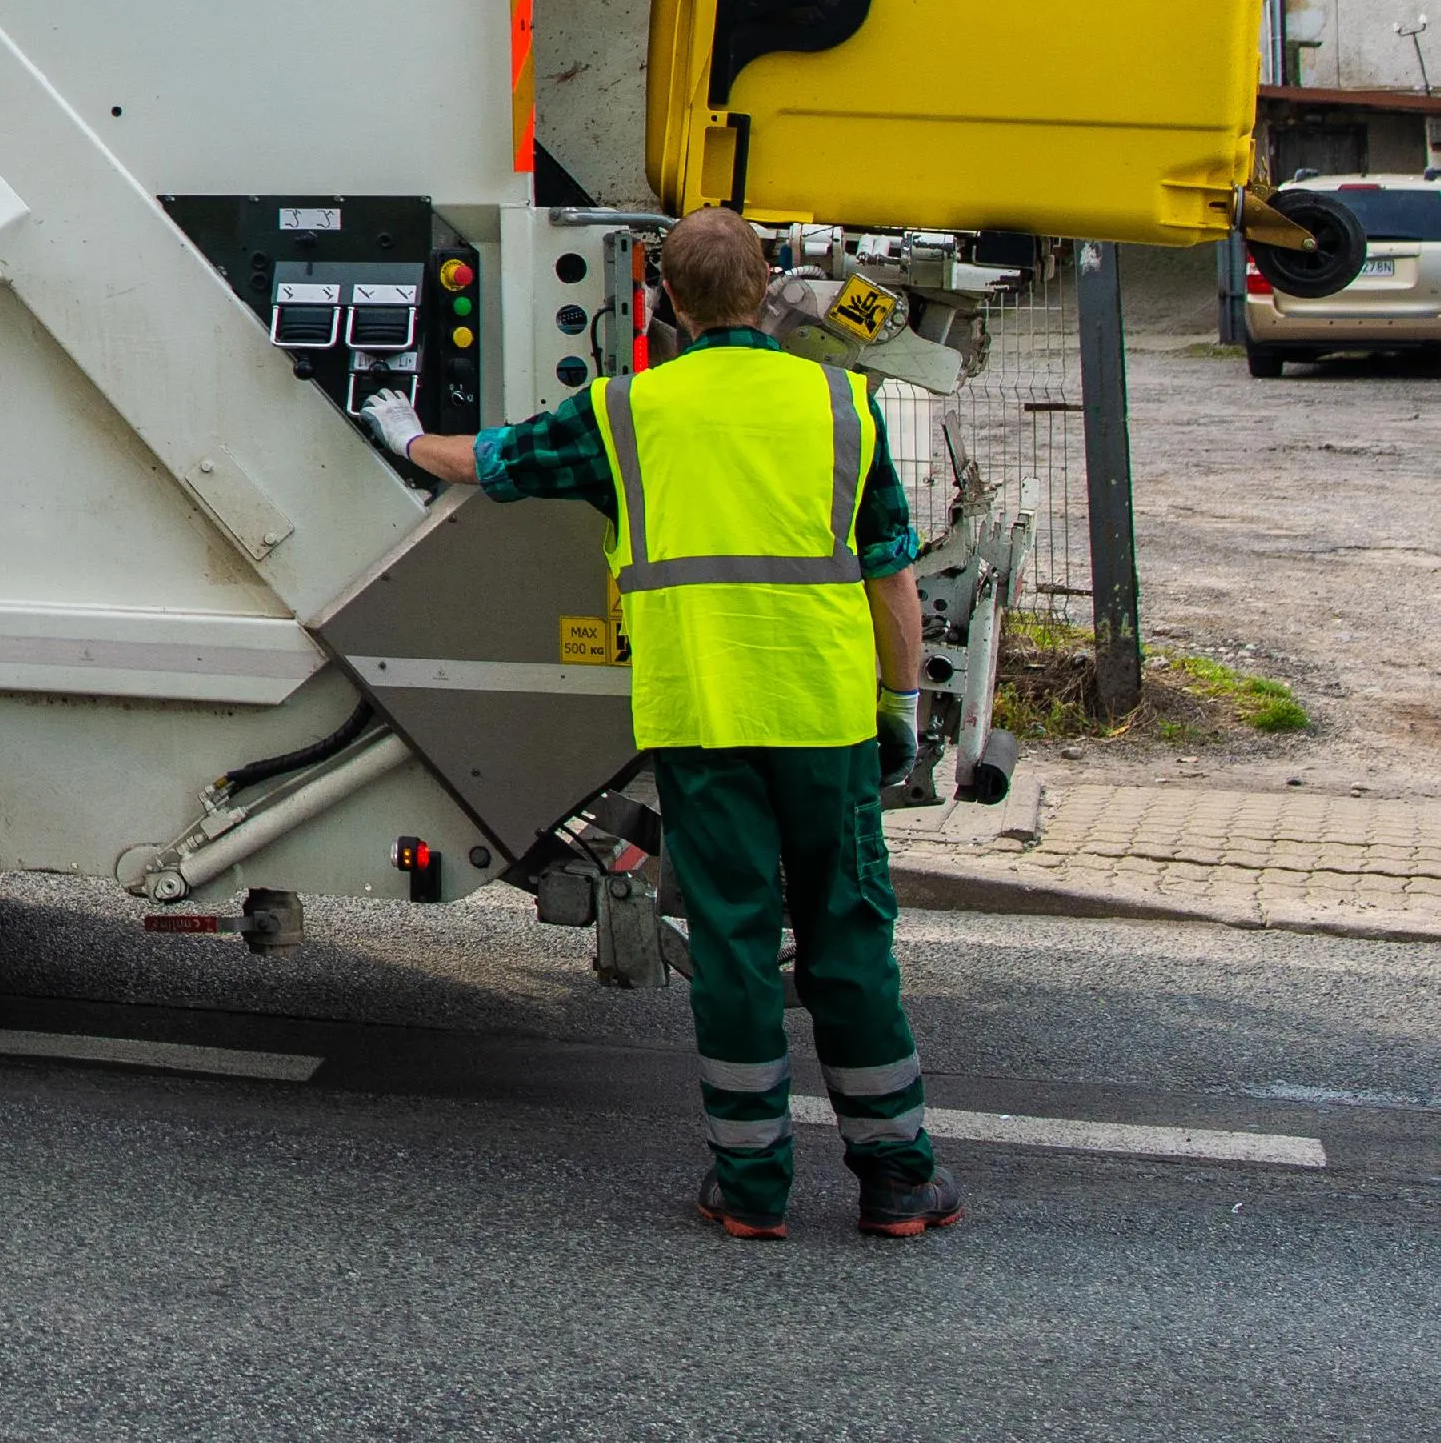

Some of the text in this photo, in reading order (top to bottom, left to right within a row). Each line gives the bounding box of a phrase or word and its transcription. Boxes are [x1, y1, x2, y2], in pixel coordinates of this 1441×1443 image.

[571, 626, 598, 639] MAX
[564, 642, 605, 656] 500 KG
